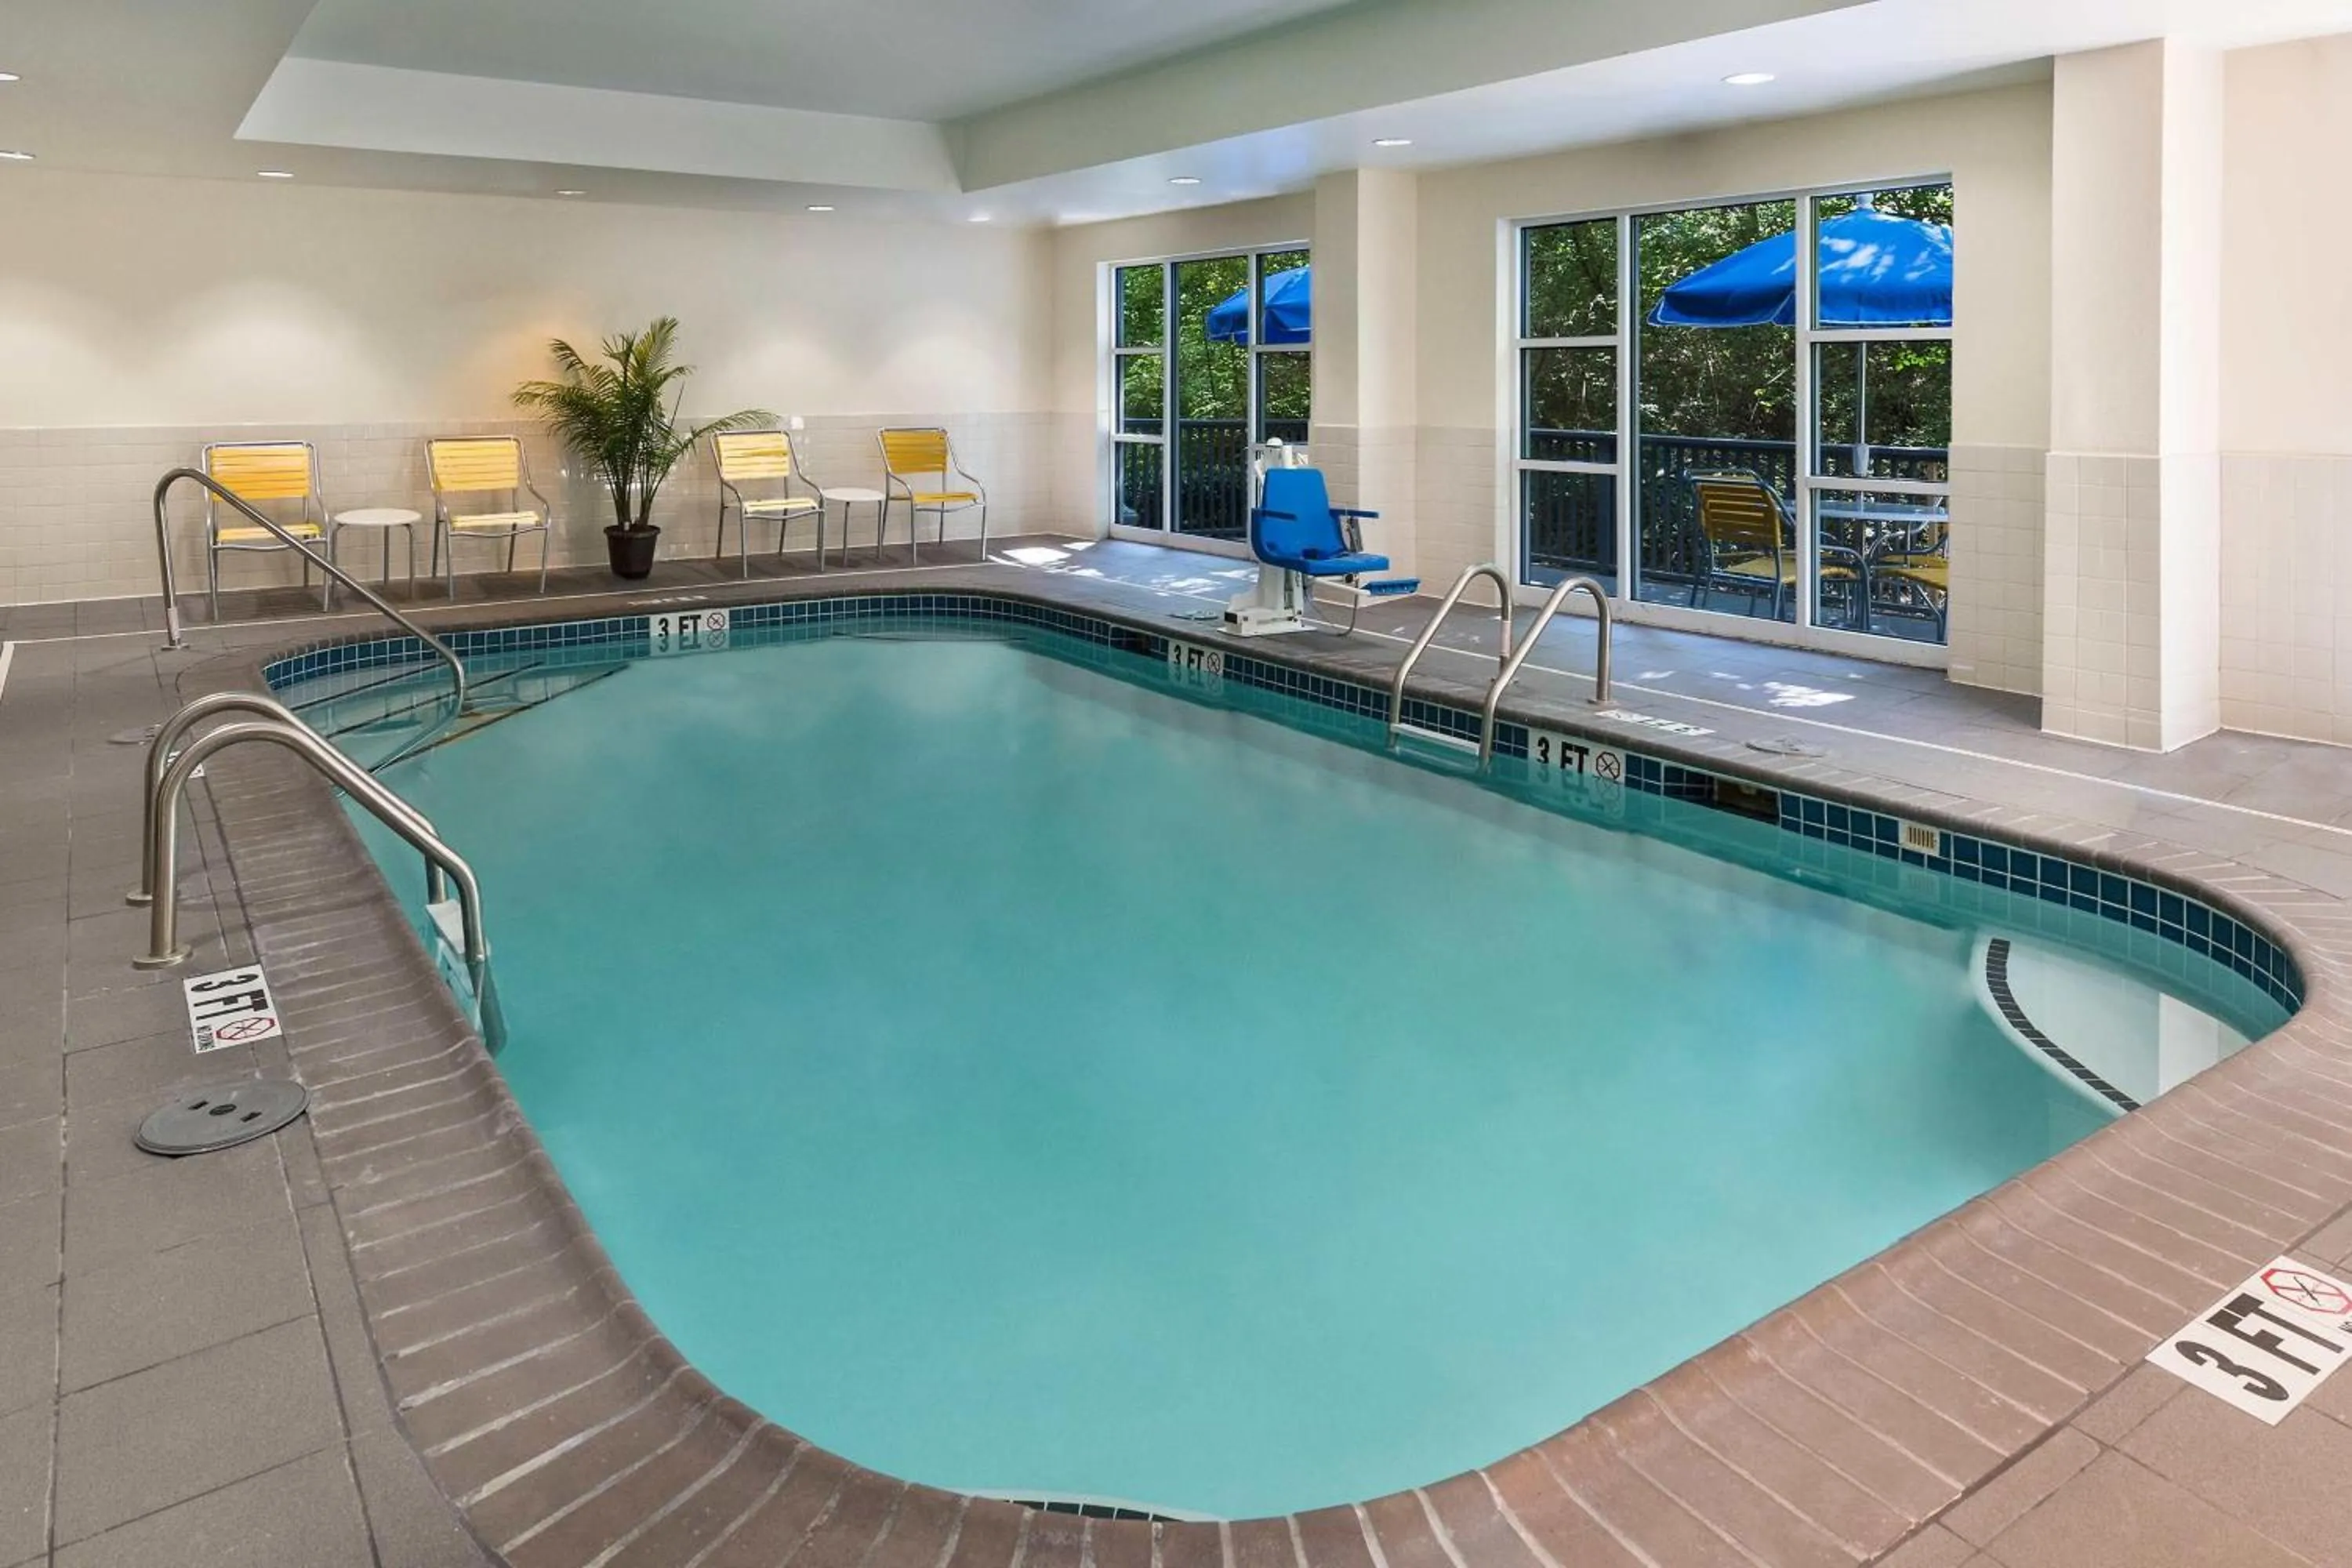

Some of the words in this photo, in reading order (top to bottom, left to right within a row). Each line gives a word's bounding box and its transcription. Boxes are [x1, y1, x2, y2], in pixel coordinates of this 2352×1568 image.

[659, 617, 669, 637] 3
[679, 615, 701, 636] FT
[1174, 644, 1181, 665] 3
[1188, 647, 1204, 671] FT
[1537, 736, 1549, 764] 3
[1560, 741, 1589, 775] FT
[191, 974, 259, 993] 3
[194, 989, 268, 1021] FT
[2205, 1292, 2345, 1376] FT
[2175, 1340, 2289, 1401] 3
